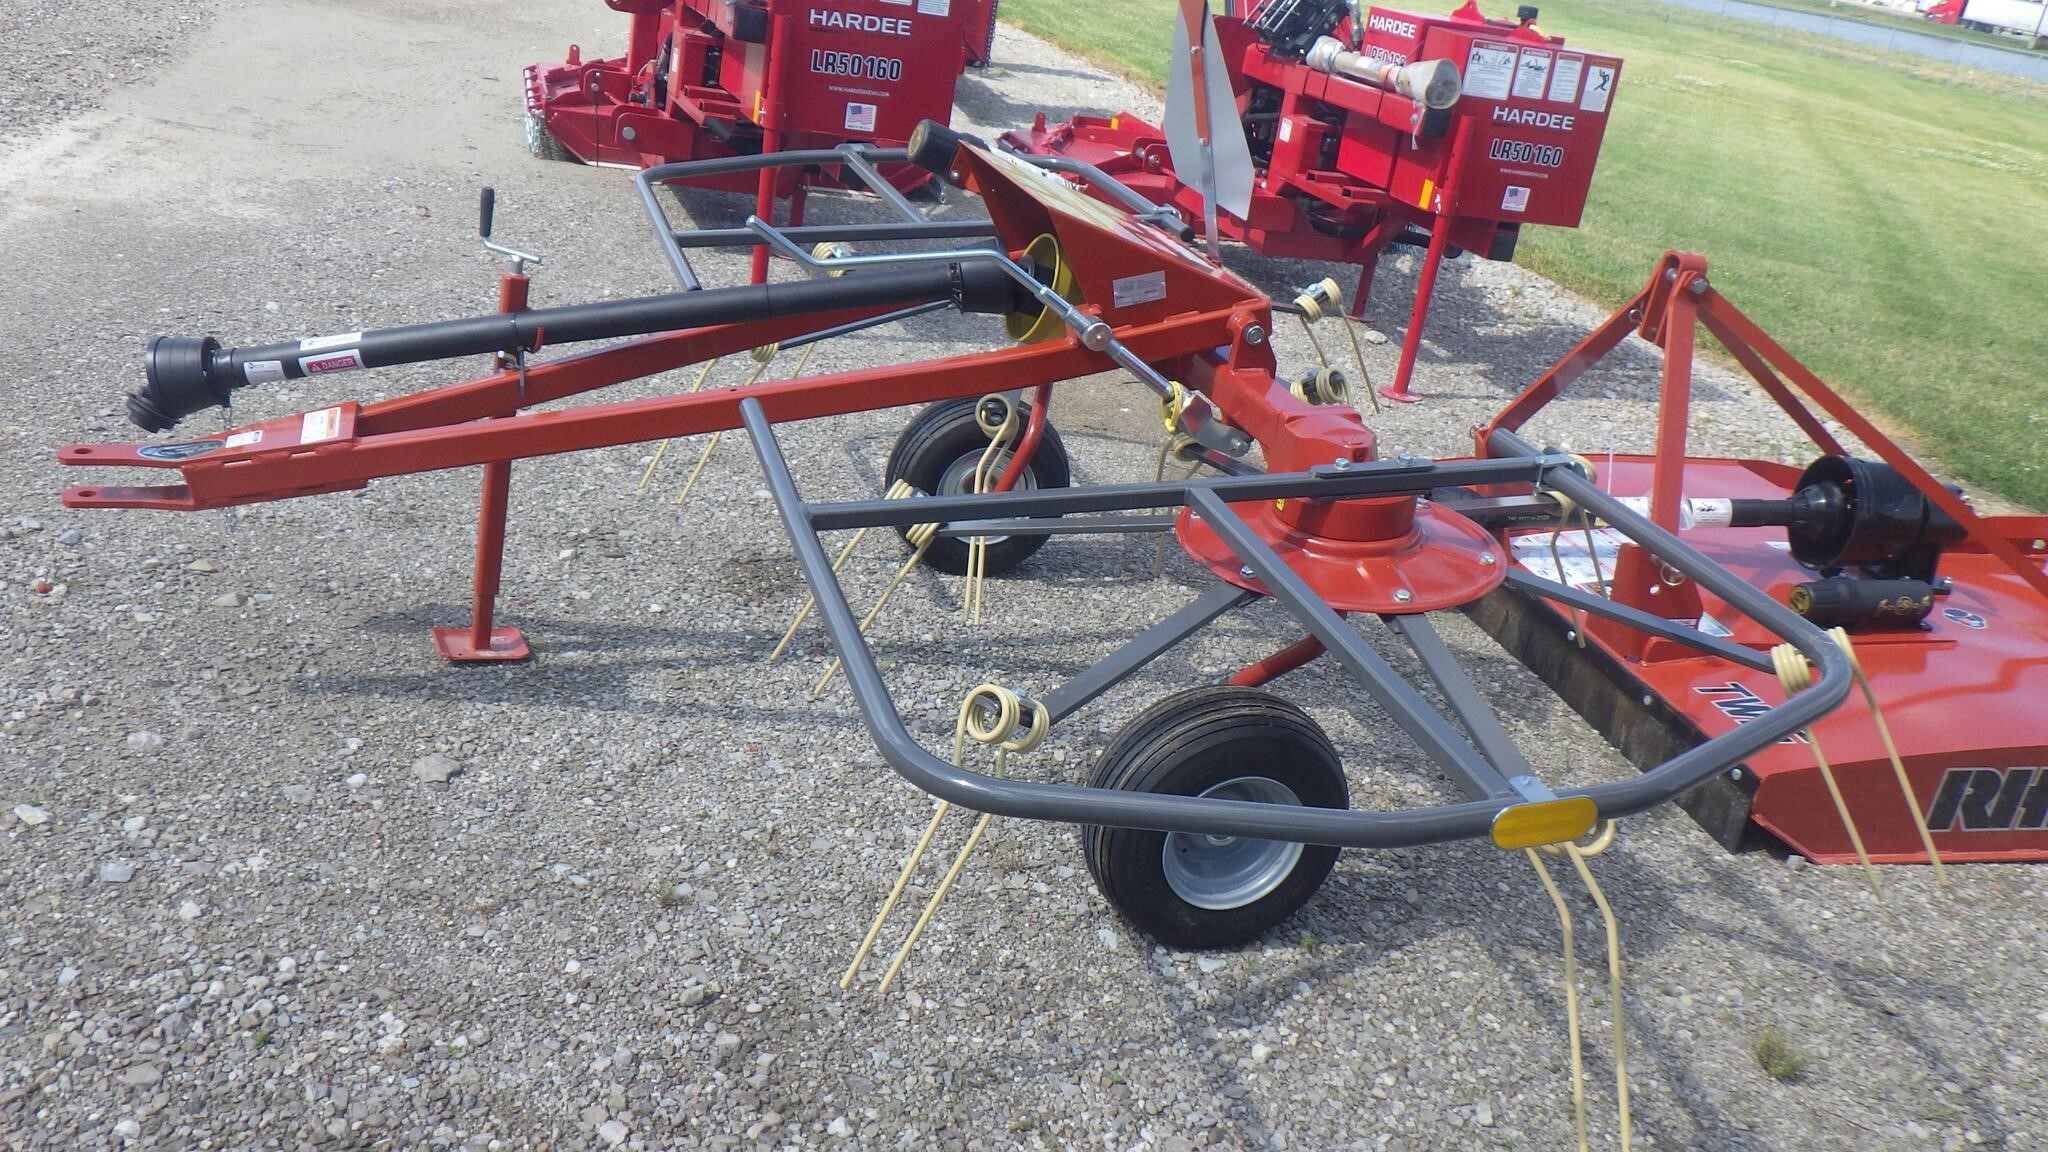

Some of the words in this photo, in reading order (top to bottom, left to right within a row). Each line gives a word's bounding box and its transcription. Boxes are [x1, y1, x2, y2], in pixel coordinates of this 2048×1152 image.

[809, 9, 913, 36] HARDEE
[1369, 14, 1417, 39] HARDEE
[811, 49, 903, 81] LR50160
[1492, 106, 1575, 131] HARDEE
[1489, 138, 1564, 167] LR50160
[321, 358, 355, 370] DANGER
